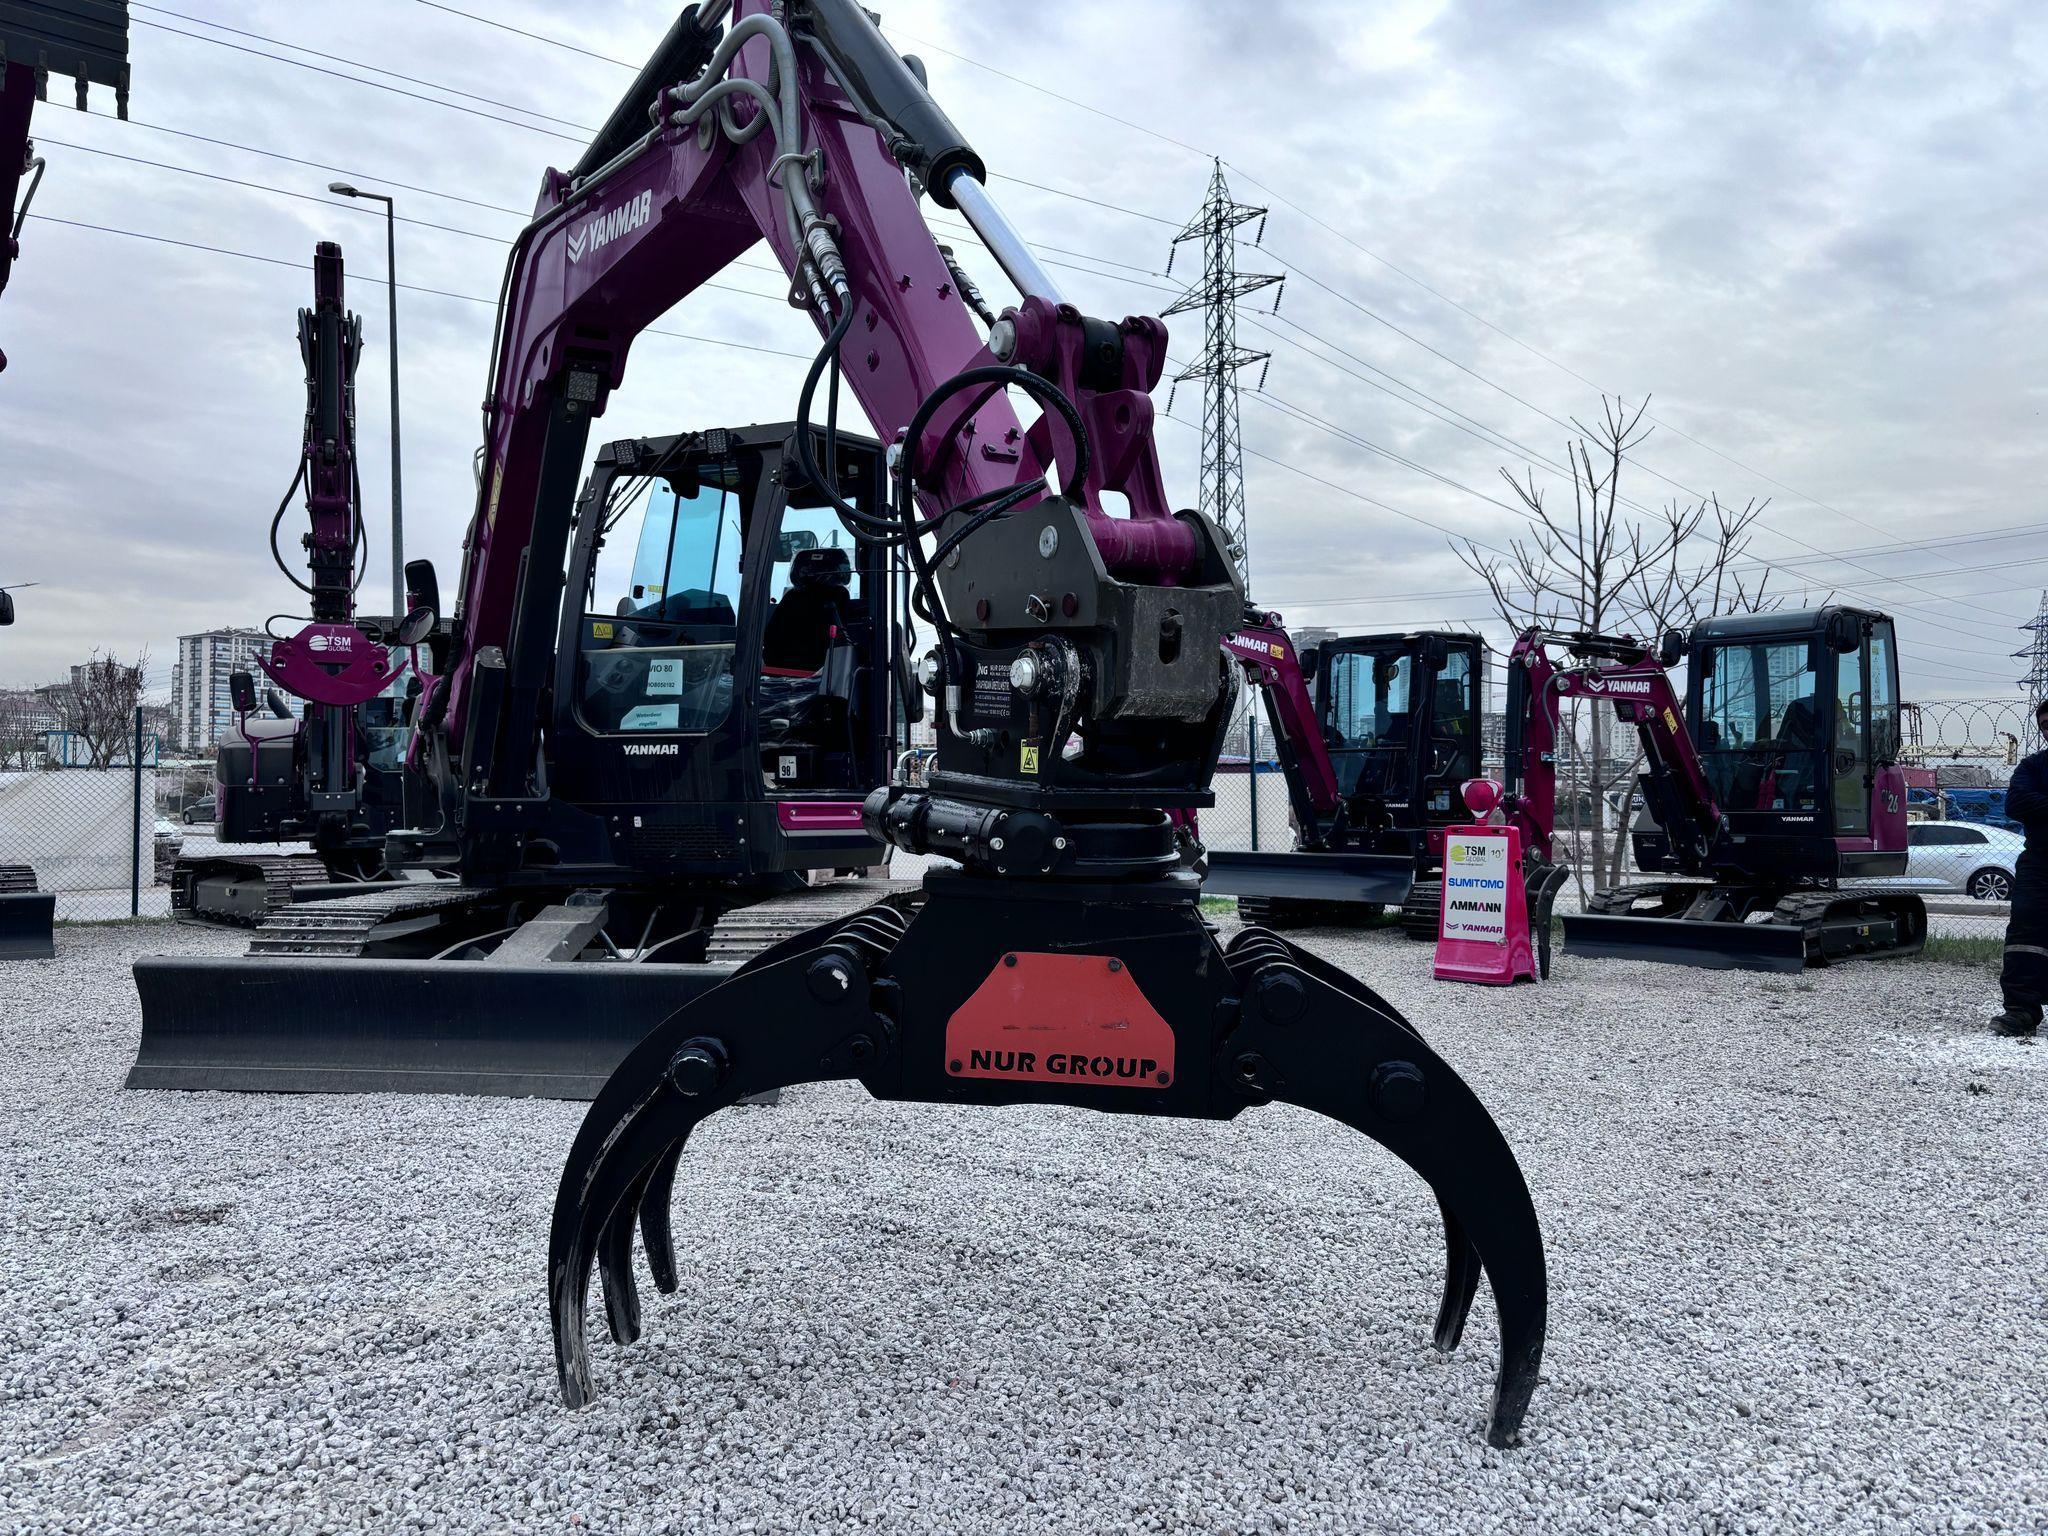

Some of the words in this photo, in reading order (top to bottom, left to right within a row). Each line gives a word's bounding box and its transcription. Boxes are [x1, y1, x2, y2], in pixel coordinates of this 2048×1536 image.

[590, 188, 652, 253] YANMAR
[327, 635, 351, 647] TSM
[663, 664, 673, 672] 80
[1607, 679, 1651, 694] YANMAR
[623, 744, 679, 755] YANMAR
[782, 765, 791, 776] 98
[1887, 794, 1898, 814] 26
[1781, 815, 1814, 823] YANMAR
[1465, 846, 1486, 856] TSM
[1448, 877, 1505, 889] SUMITOMO
[1449, 900, 1502, 913] AMMANN
[1461, 923, 1503, 934] YANMAR
[970, 1049, 1036, 1073] NUR
[1045, 1053, 1157, 1079] GROUP
